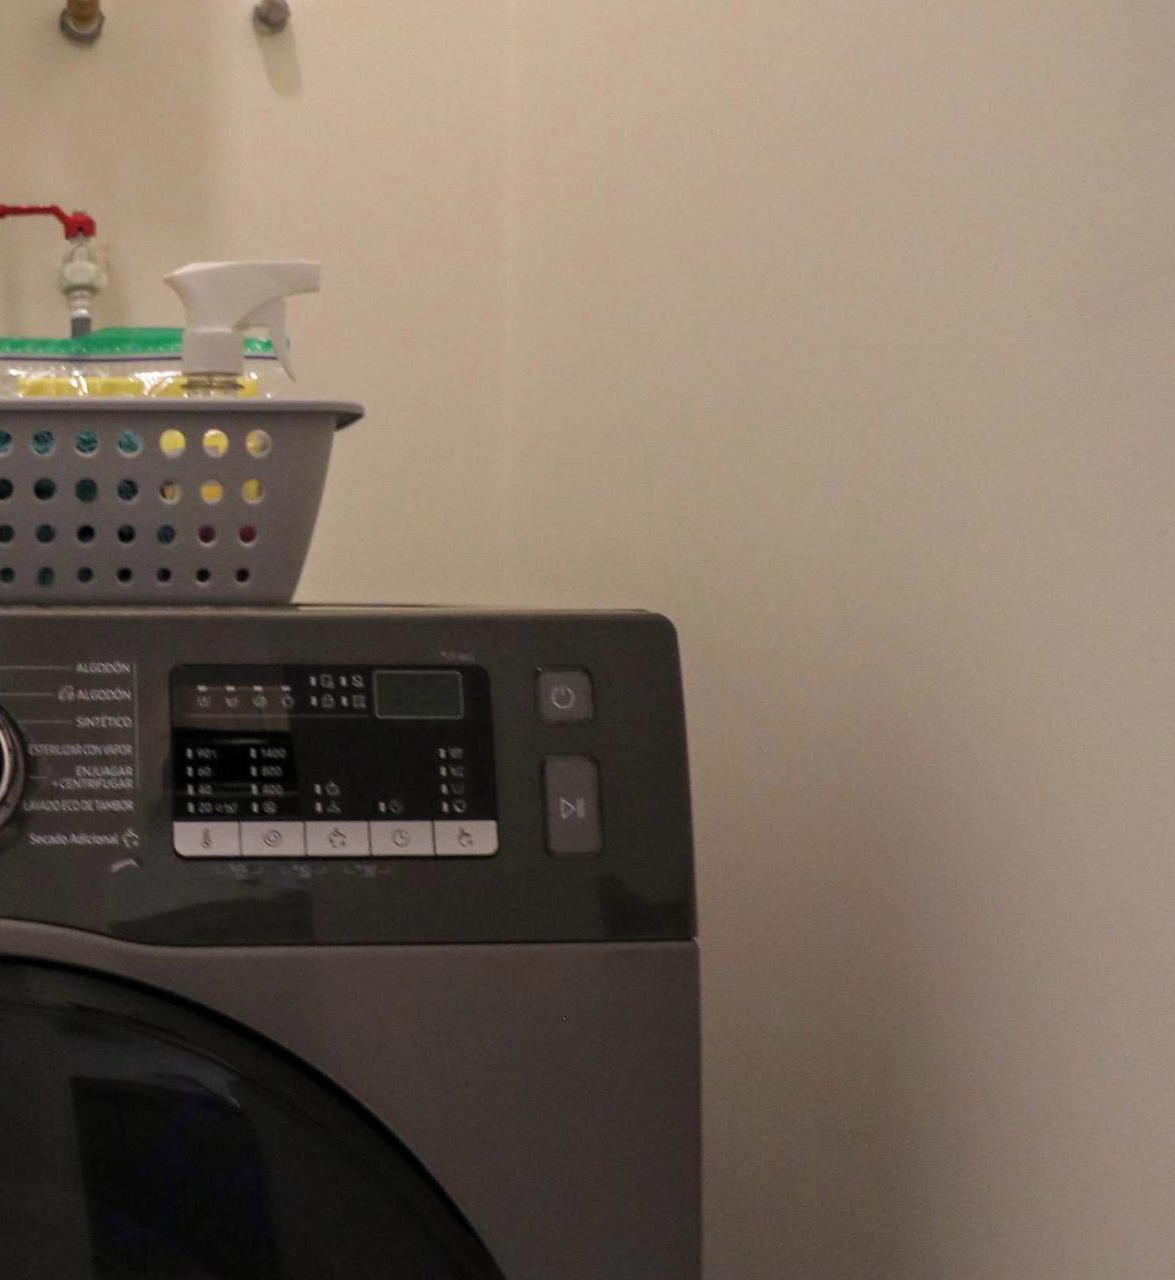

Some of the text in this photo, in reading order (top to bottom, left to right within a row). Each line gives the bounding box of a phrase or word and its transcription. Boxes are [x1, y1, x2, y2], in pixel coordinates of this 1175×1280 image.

[28, 743, 133, 756] ESTERILIZAR CON VAPOR
[75, 765, 133, 777] ENJUAGAR
[23, 800, 60, 812] LAVADO
[61, 800, 82, 812] ECO
[95, 800, 134, 812] TAMBOR
[28, 832, 120, 845] Secado Adicional
